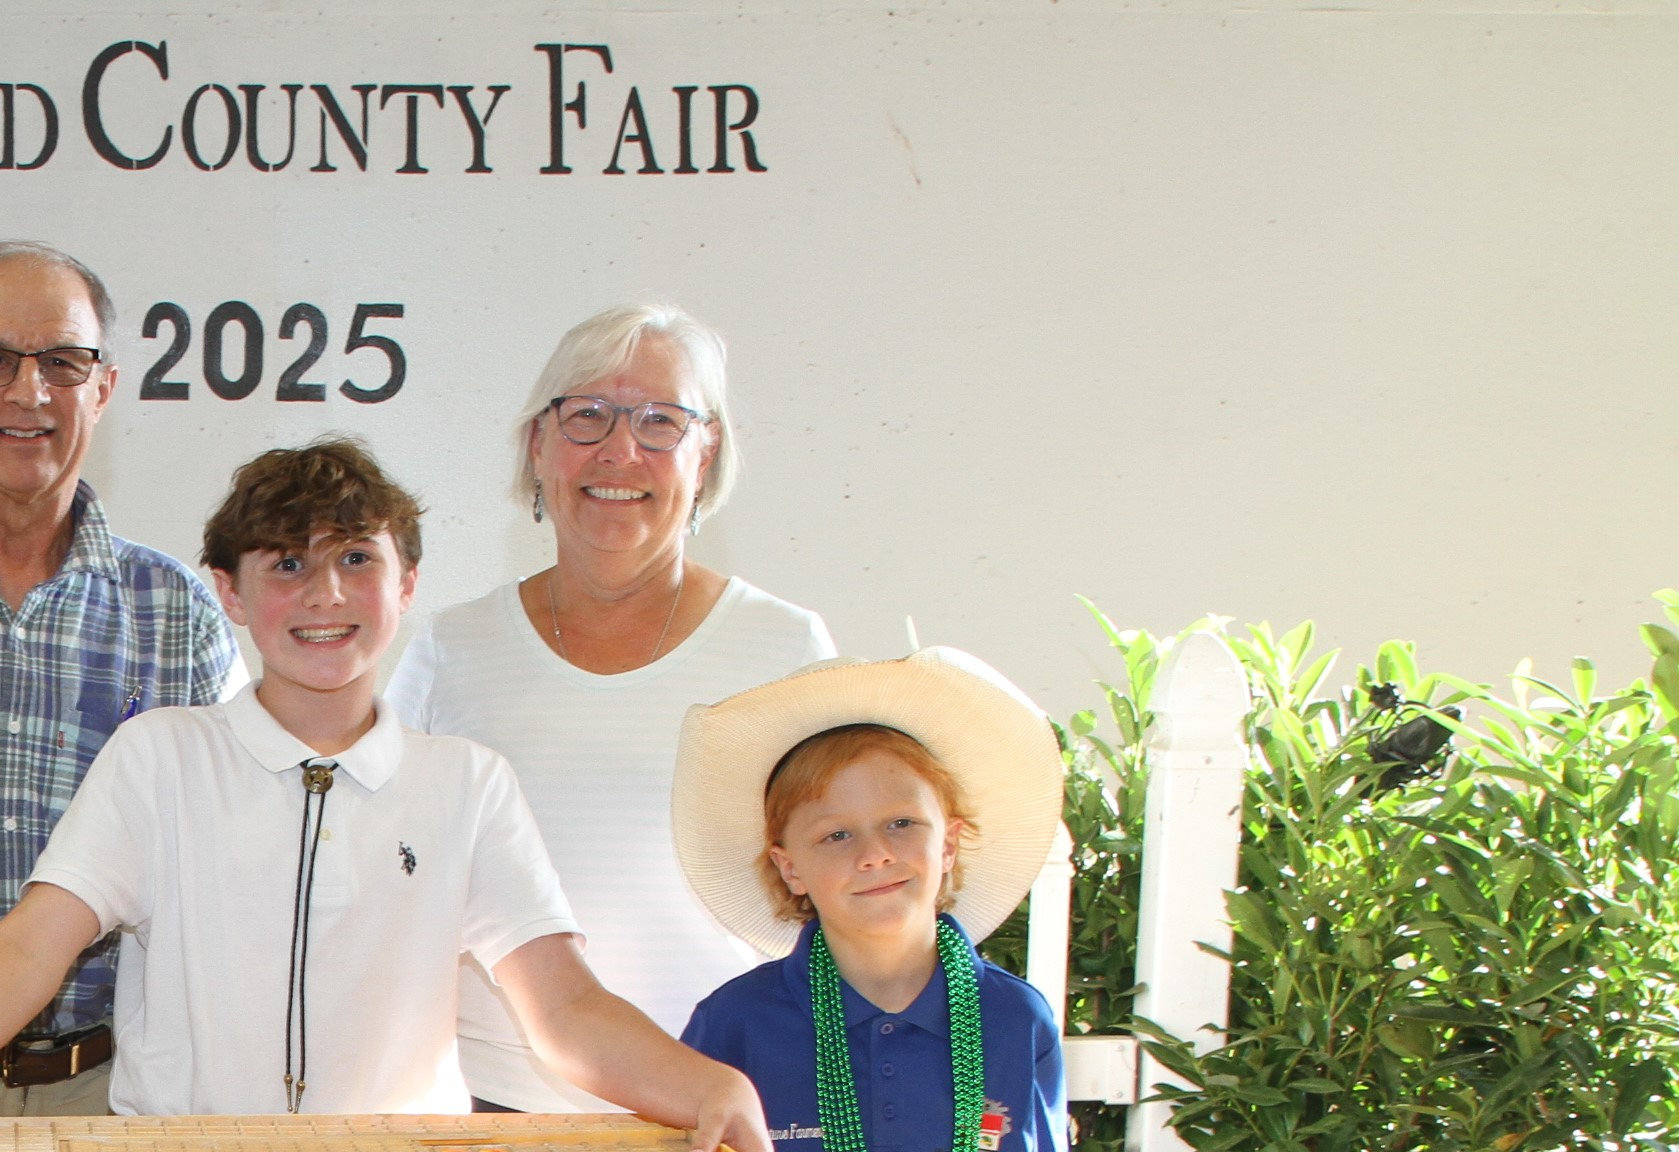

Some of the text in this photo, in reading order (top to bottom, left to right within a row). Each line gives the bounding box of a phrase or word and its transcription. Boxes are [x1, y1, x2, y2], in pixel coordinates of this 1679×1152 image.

[82, 39, 510, 176] COUNTY
[534, 43, 769, 176] FAIR
[139, 300, 408, 404] 2025
